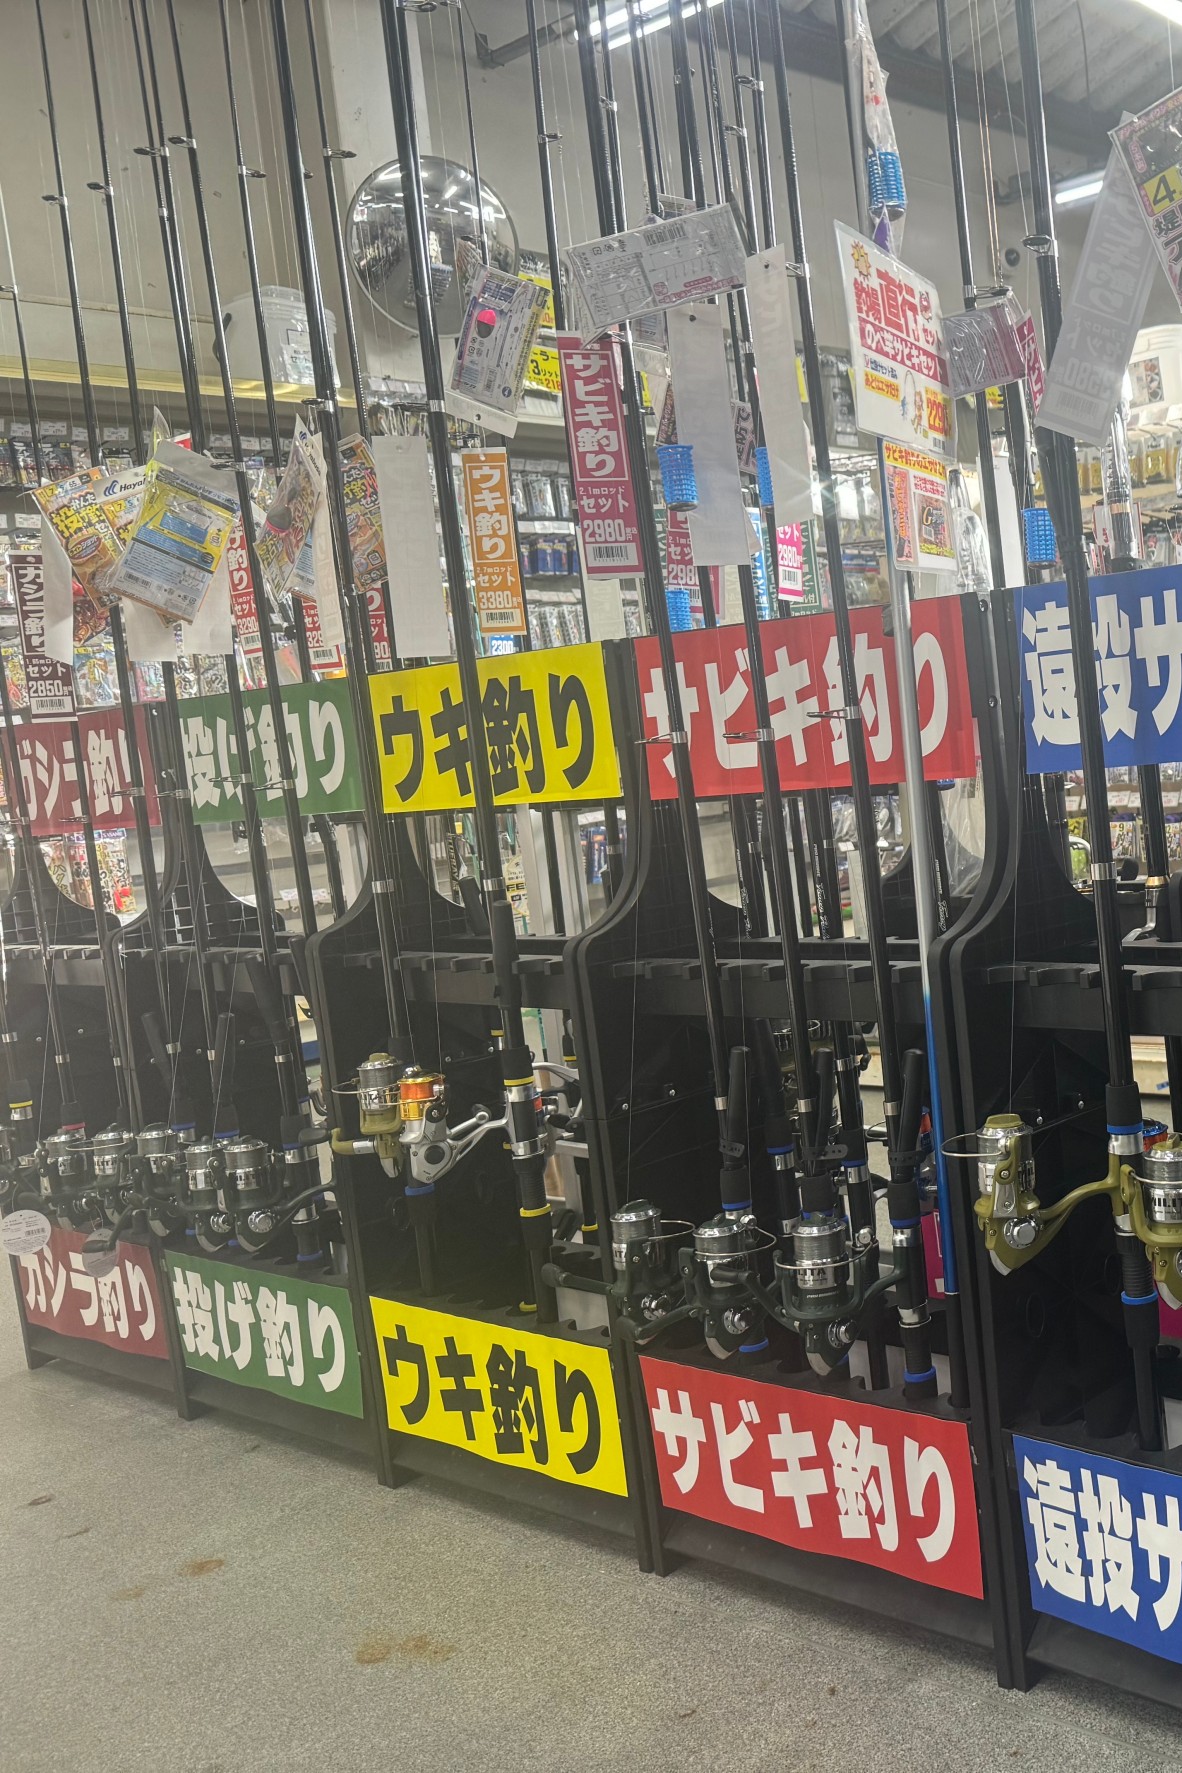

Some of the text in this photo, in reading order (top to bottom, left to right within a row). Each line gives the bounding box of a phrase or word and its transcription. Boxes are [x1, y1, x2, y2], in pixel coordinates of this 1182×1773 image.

[1152, 174, 1177, 206] 4
[565, 353, 619, 478] サビキ釣り
[579, 485, 625, 496] 2.1mロッド
[580, 494, 630, 514] セット
[471, 465, 508, 559] ウキ釣り
[583, 518, 626, 542] 2980
[477, 572, 516, 588] セット
[478, 590, 512, 609] 3380
[491, 640, 514, 654] 2300
[26, 663, 67, 678] セット
[28, 679, 63, 698] 2850
[642, 630, 949, 780] サビキ釣り
[378, 673, 595, 803] ウキ釣り
[179, 699, 346, 810] 投げ釣り
[172, 1265, 347, 1394] 投げ釣り
[381, 1323, 600, 1475] ウキ釣り
[651, 1387, 956, 1564] サビキ釣り
